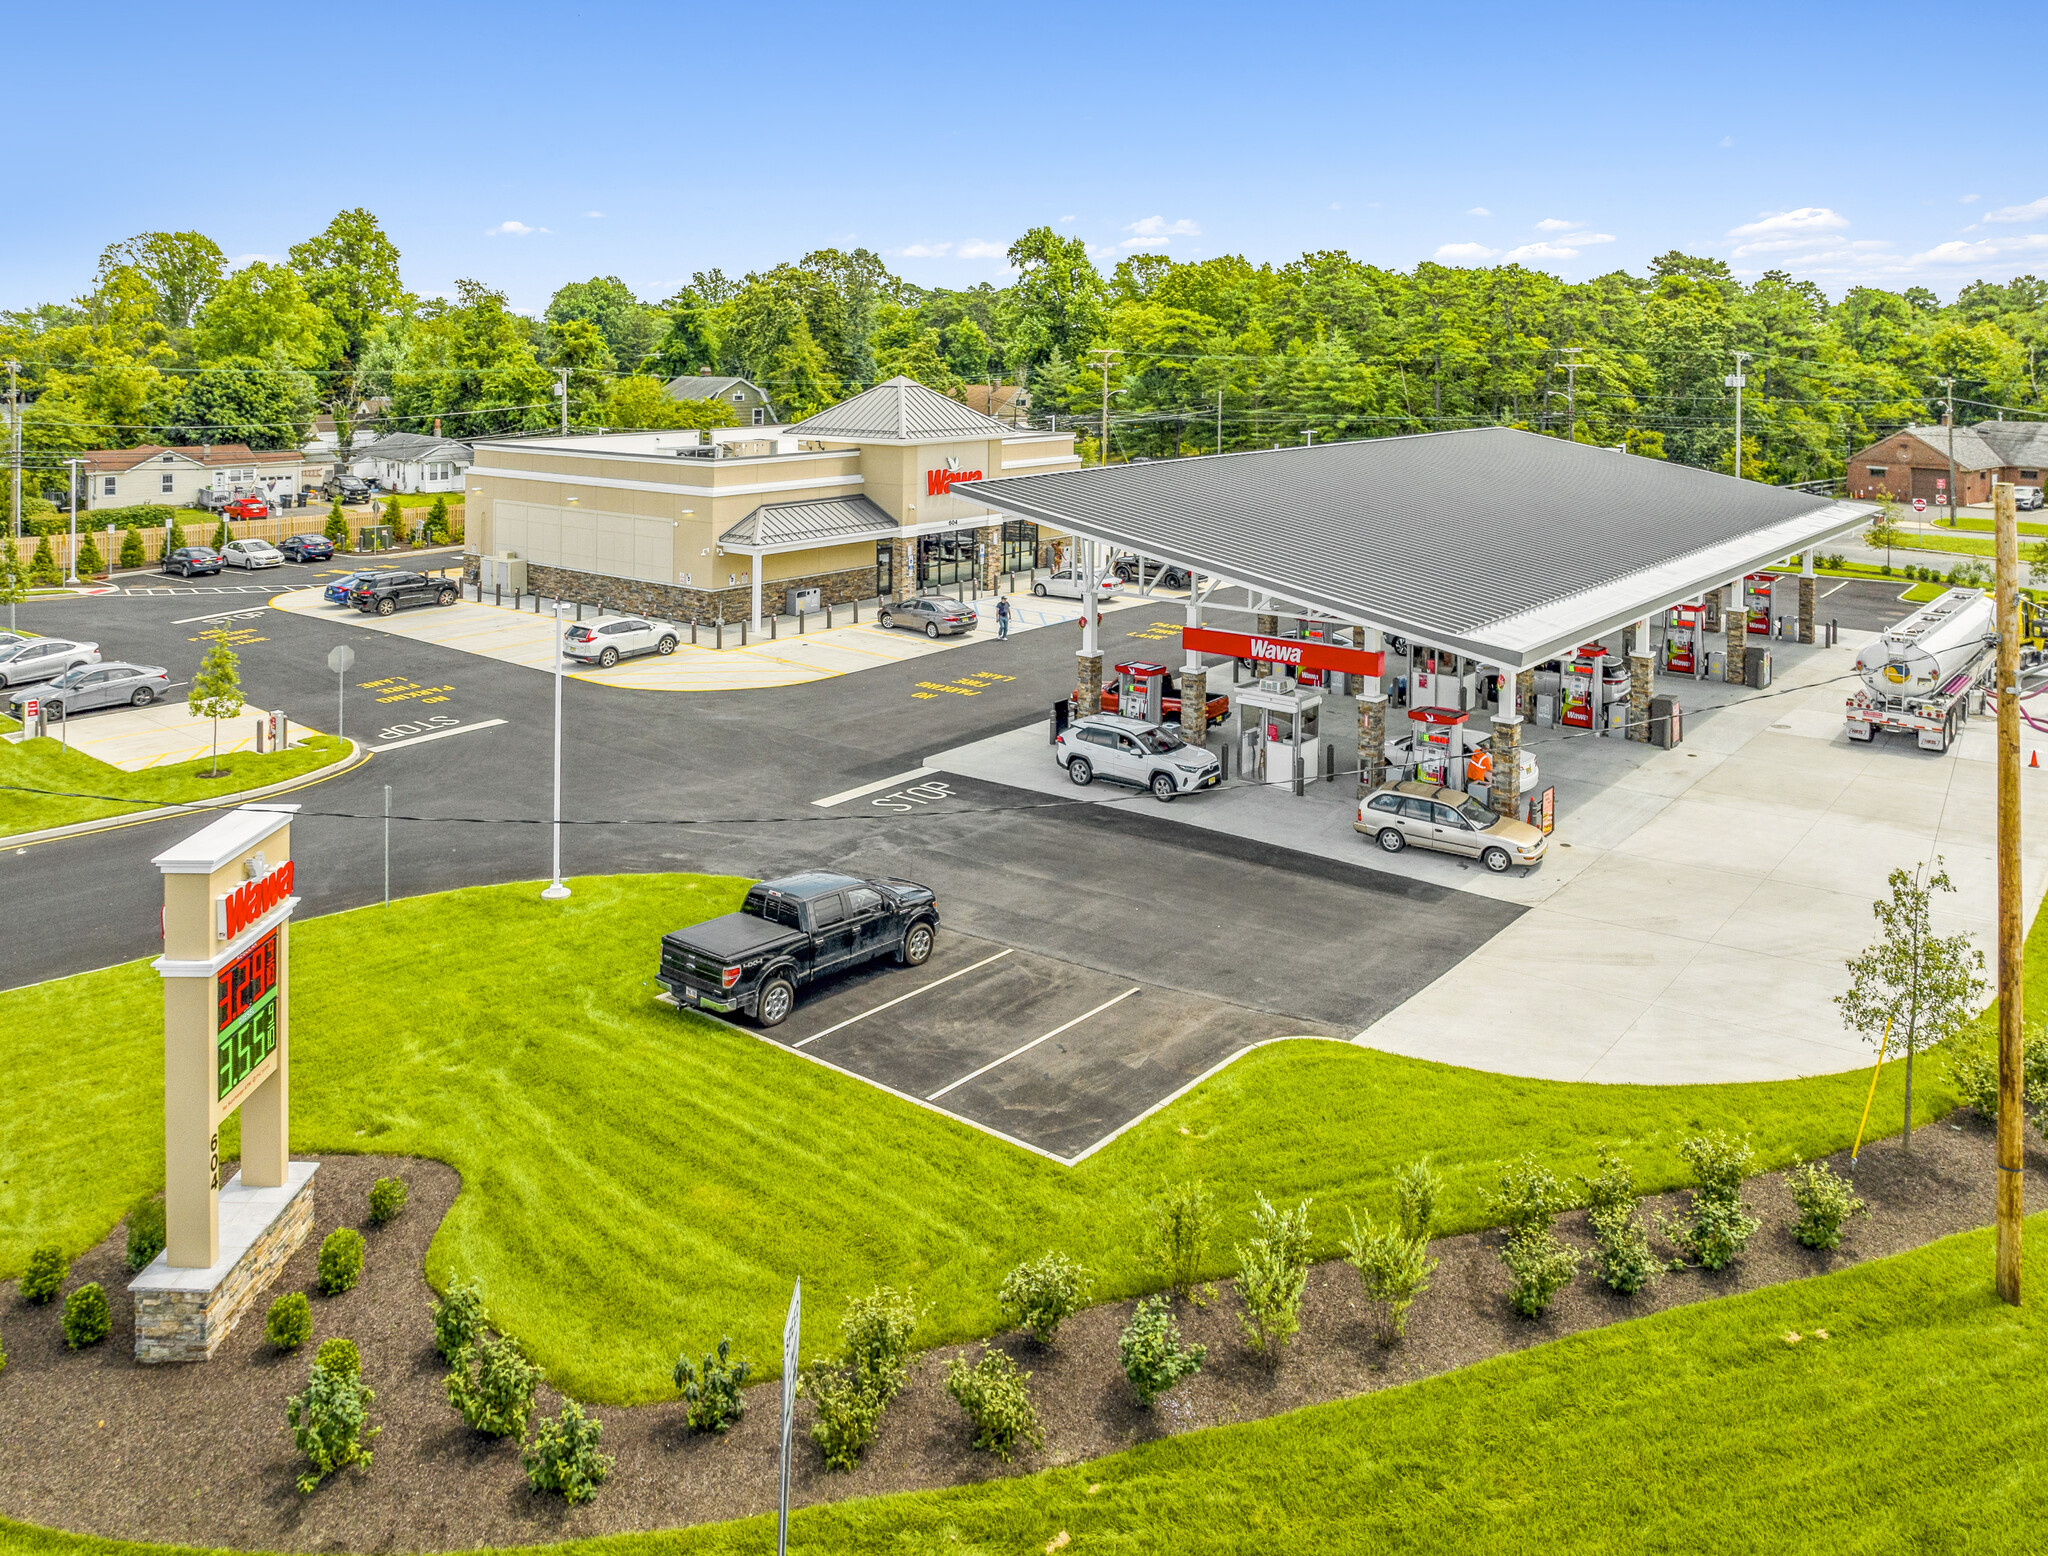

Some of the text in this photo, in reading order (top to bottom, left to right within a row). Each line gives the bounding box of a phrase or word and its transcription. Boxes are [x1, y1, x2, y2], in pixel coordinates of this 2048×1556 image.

[202, 612, 265, 625] STOP
[1250, 638, 1301, 663] Wawa
[356, 676, 408, 689] LANE
[375, 685, 456, 704] PARKING
[376, 683, 422, 694] FIRE
[421, 695, 451, 704] NO
[378, 715, 461, 739] STOP
[1567, 711, 1589, 721] Wawa
[871, 781, 957, 813] STOP
[225, 860, 294, 940] Wawa
[218, 945, 266, 1031] 3.29
[219, 1009, 266, 1099] 3.55
[210, 1132, 218, 1191] 604
